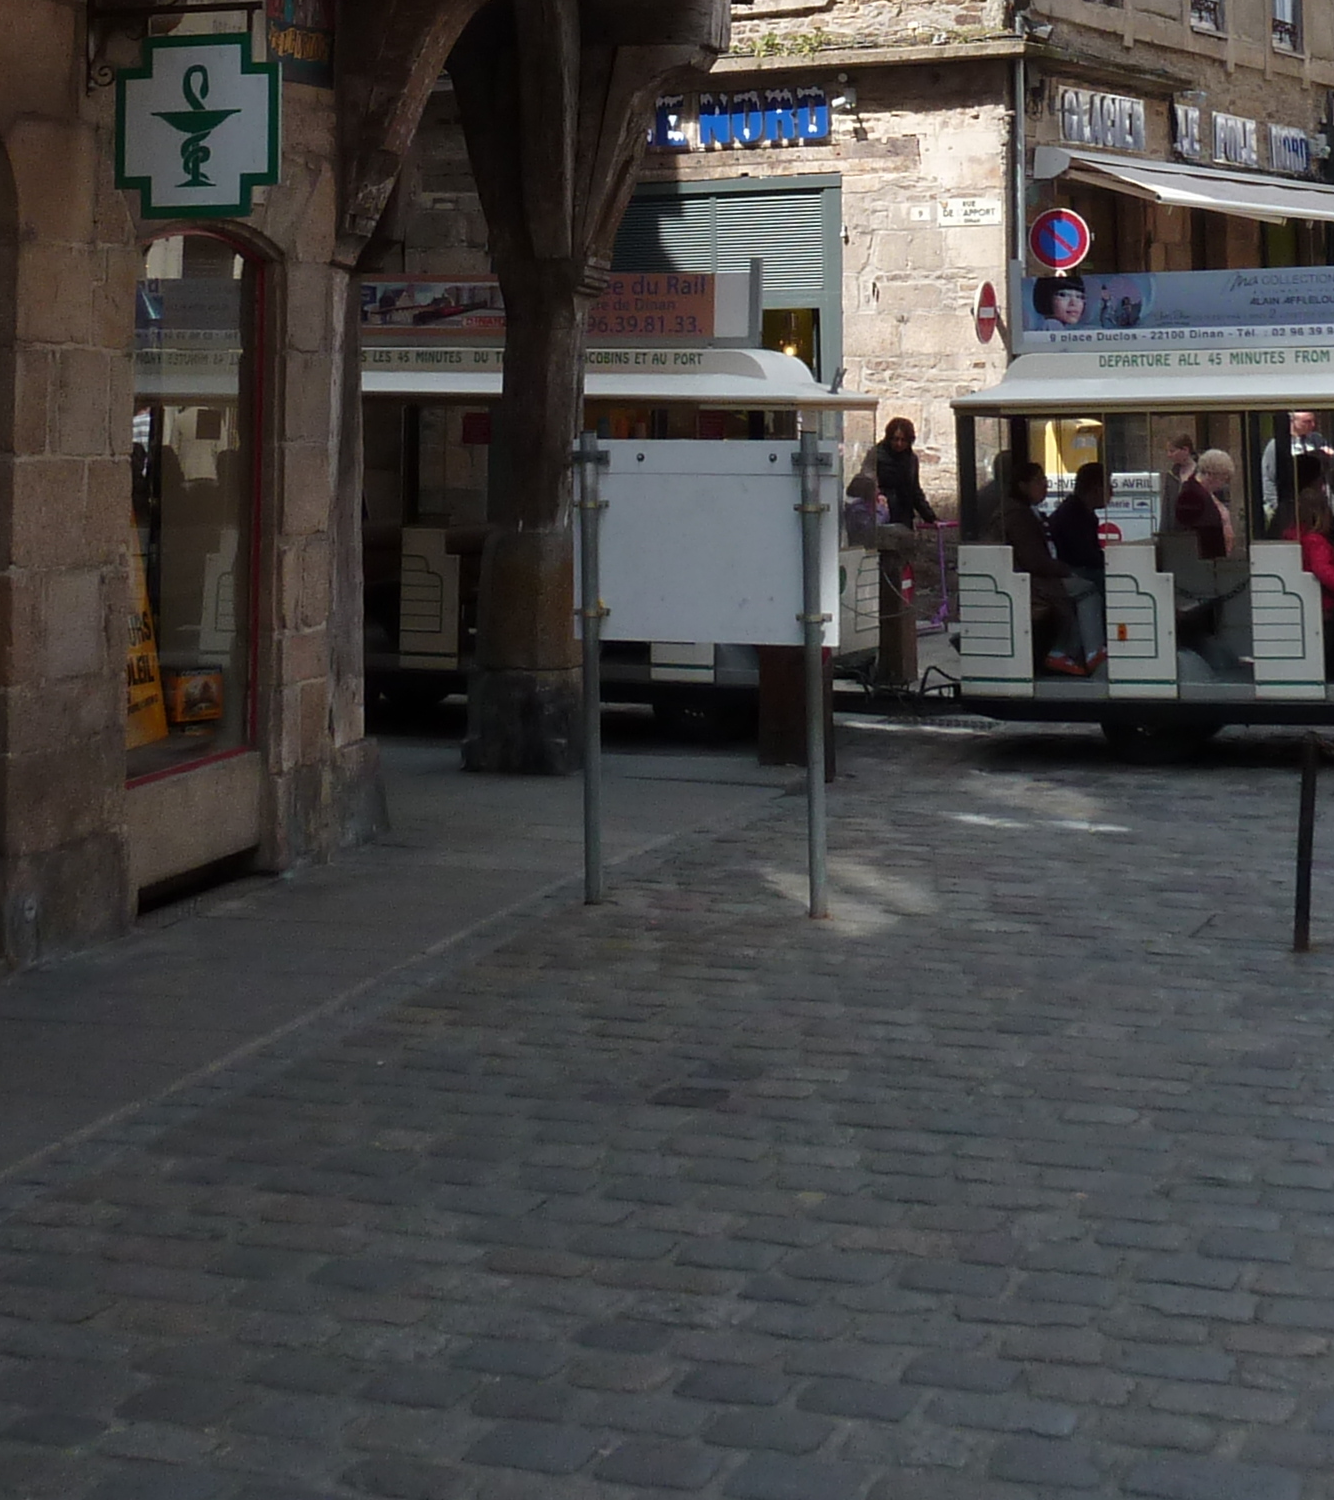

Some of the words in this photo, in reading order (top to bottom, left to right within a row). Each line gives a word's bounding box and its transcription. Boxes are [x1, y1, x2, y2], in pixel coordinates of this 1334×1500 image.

[699, 87, 829, 145] NORD
[962, 200, 976, 208] RUE
[942, 209, 954, 218] DE
[632, 275, 659, 295] du
[667, 275, 706, 296] Rail
[1250, 296, 1280, 305] ALAIN
[1096, 331, 1138, 342] Duclos
[1150, 328, 1185, 341] 22100
[1189, 327, 1225, 339] Dinan
[1271, 327, 1286, 337] 02
[1289, 327, 1305, 337] 96
[1307, 326, 1323, 336] 39
[372, 350, 392, 363] LES
[397, 351, 410, 363] 45
[415, 350, 462, 364] MINUTES
[473, 350, 489, 363] DU
[634, 353, 648, 365] ET
[651, 352, 668, 365] AU
[673, 353, 704, 365] PORT
[1098, 353, 1172, 368] DEPARTURE
[1178, 353, 1202, 366] ALL
[1207, 352, 1223, 366] 45
[1229, 350, 1286, 365] MINUTES
[1294, 349, 1330, 364] FROM
[1122, 478, 1153, 489] AVRIL
